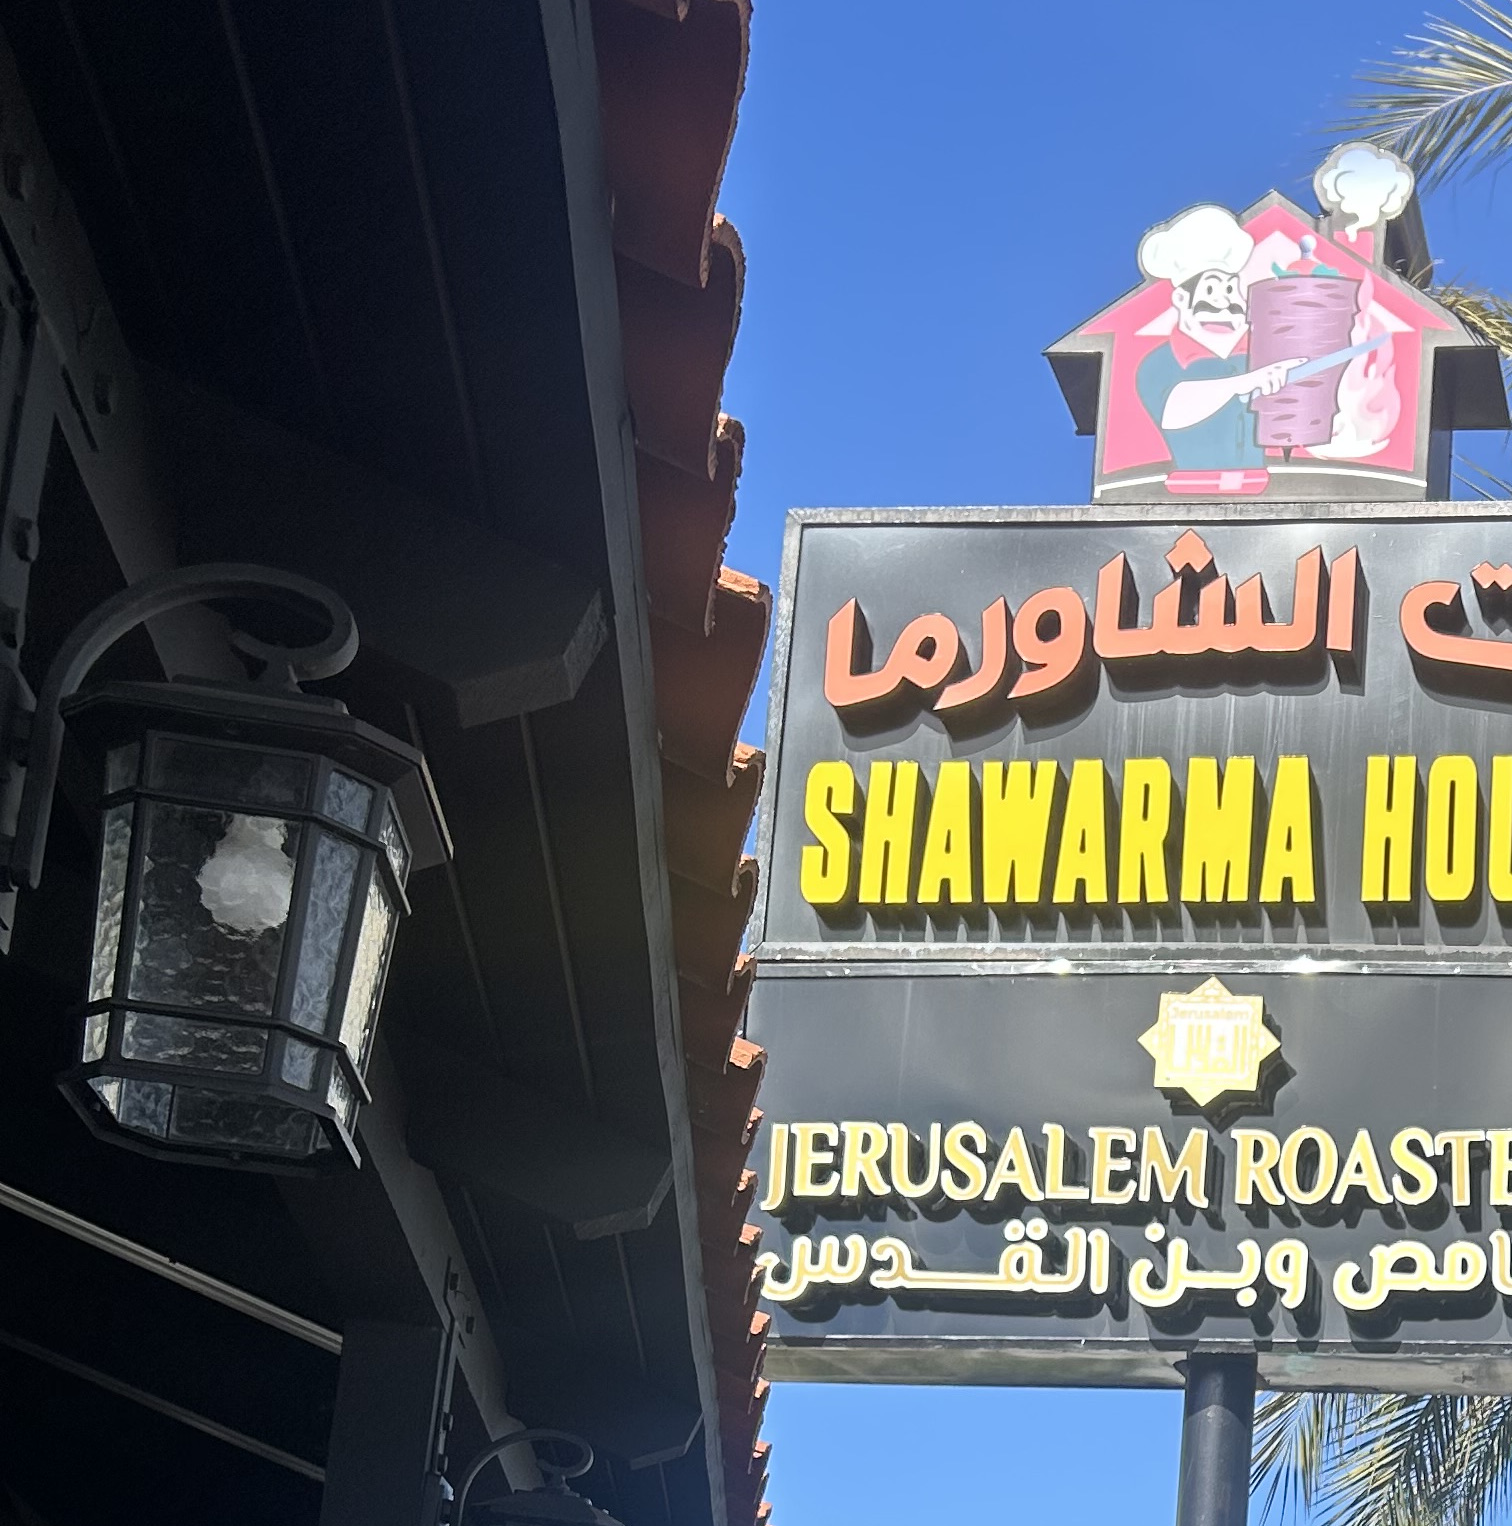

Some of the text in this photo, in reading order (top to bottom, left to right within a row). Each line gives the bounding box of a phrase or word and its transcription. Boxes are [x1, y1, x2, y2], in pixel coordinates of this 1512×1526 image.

[822, 528, 1358, 710] الشاورما
[801, 755, 1315, 905] SHAWARMA
[760, 1122, 1209, 1212] JERUSALEM
